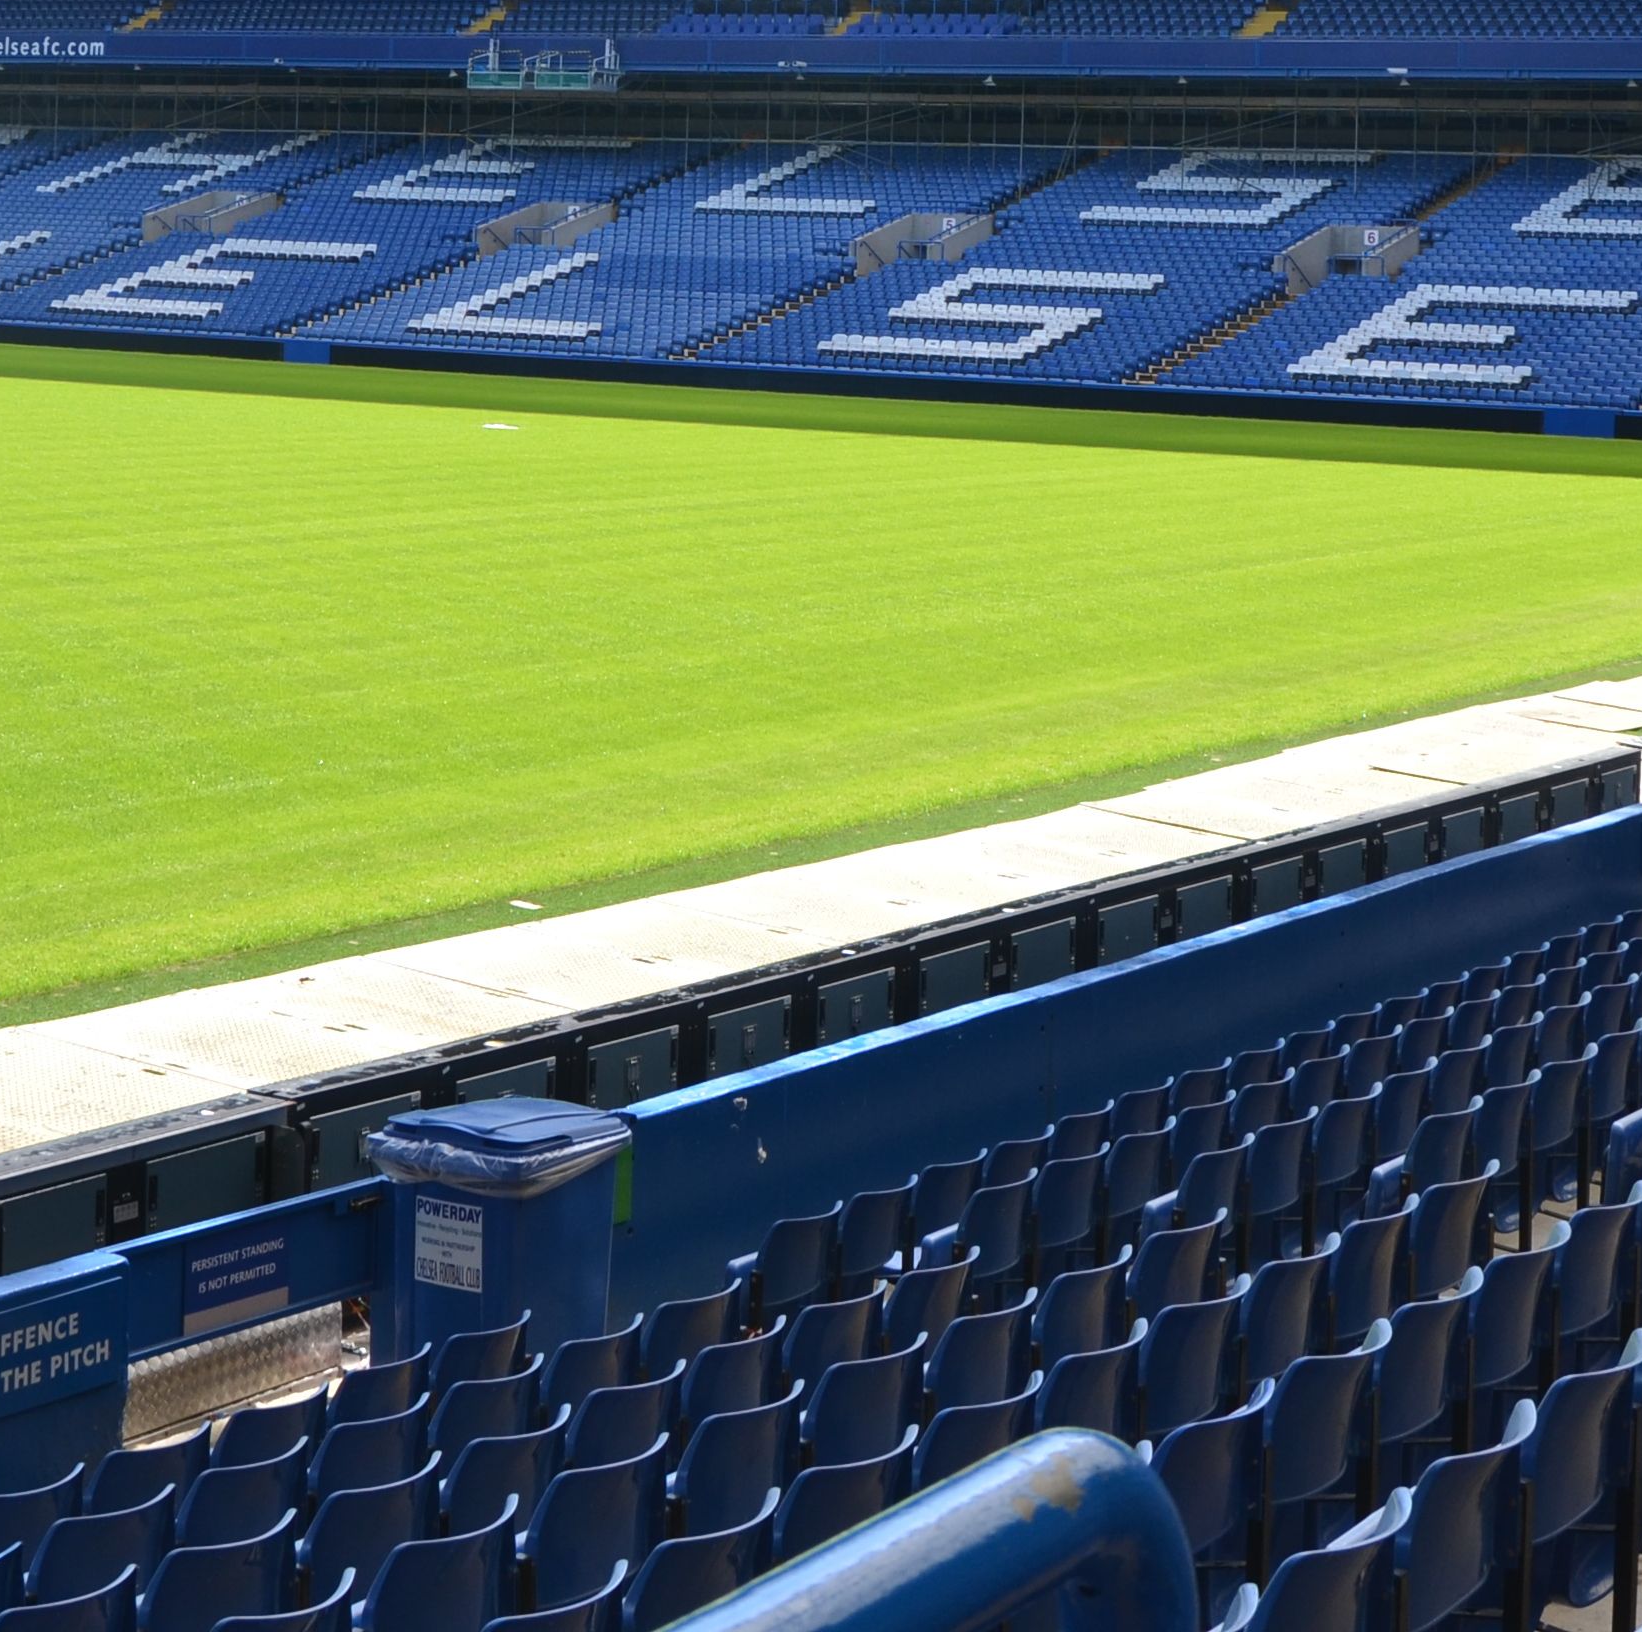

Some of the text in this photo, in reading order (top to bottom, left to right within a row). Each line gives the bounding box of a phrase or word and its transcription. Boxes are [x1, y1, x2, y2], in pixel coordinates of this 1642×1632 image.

[1367, 232, 1376, 244] 6
[417, 1198, 482, 1224] POWERDAY
[191, 1237, 284, 1273] PERSISTENT STANDING
[198, 1262, 276, 1294] IS NOT PERMITTED
[0, 1360, 41, 1394] THE
[50, 1338, 110, 1379] PITCH
